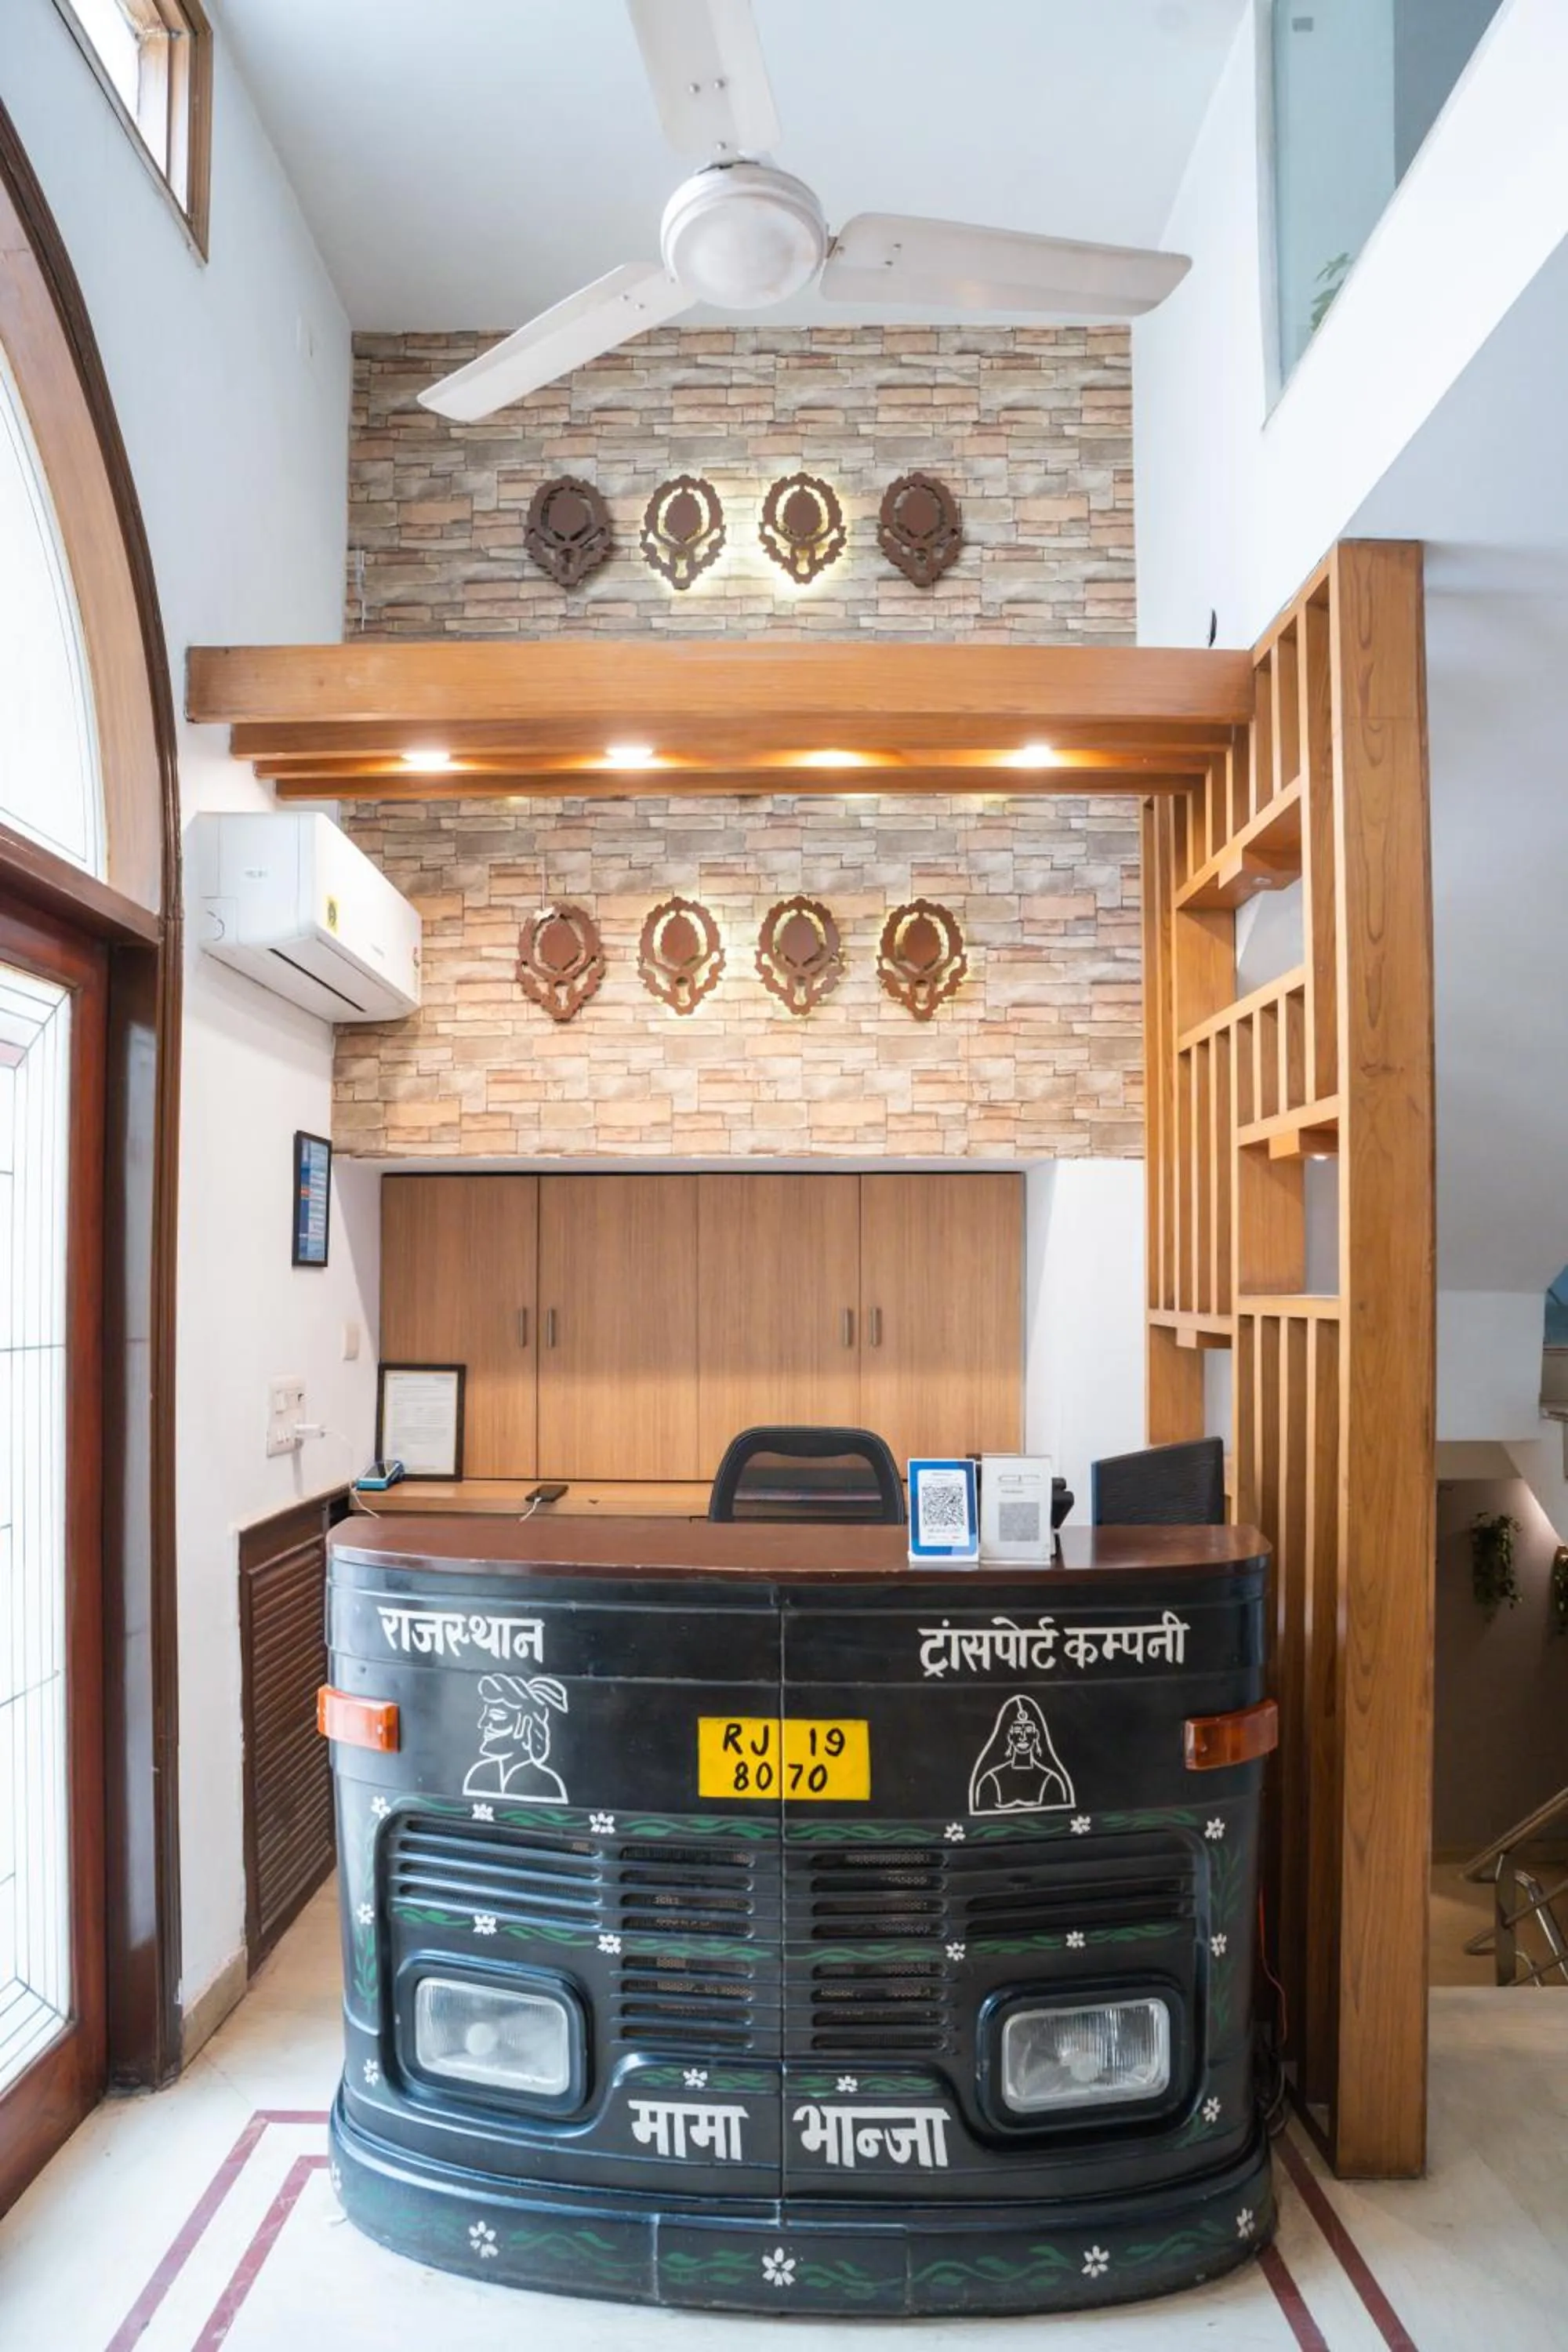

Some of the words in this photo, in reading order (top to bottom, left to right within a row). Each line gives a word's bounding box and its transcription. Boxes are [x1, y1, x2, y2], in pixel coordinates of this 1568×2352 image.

[378, 1607, 545, 1663] राजस्थान
[917, 1616, 1059, 1678] ट्रांसपोर्ट
[1064, 1610, 1191, 1669] कम्पनी
[723, 1722, 769, 1756] RJ
[809, 1727, 845, 1757] 19
[627, 2099, 750, 2161] मामा
[792, 2104, 951, 2168] भान्जा
